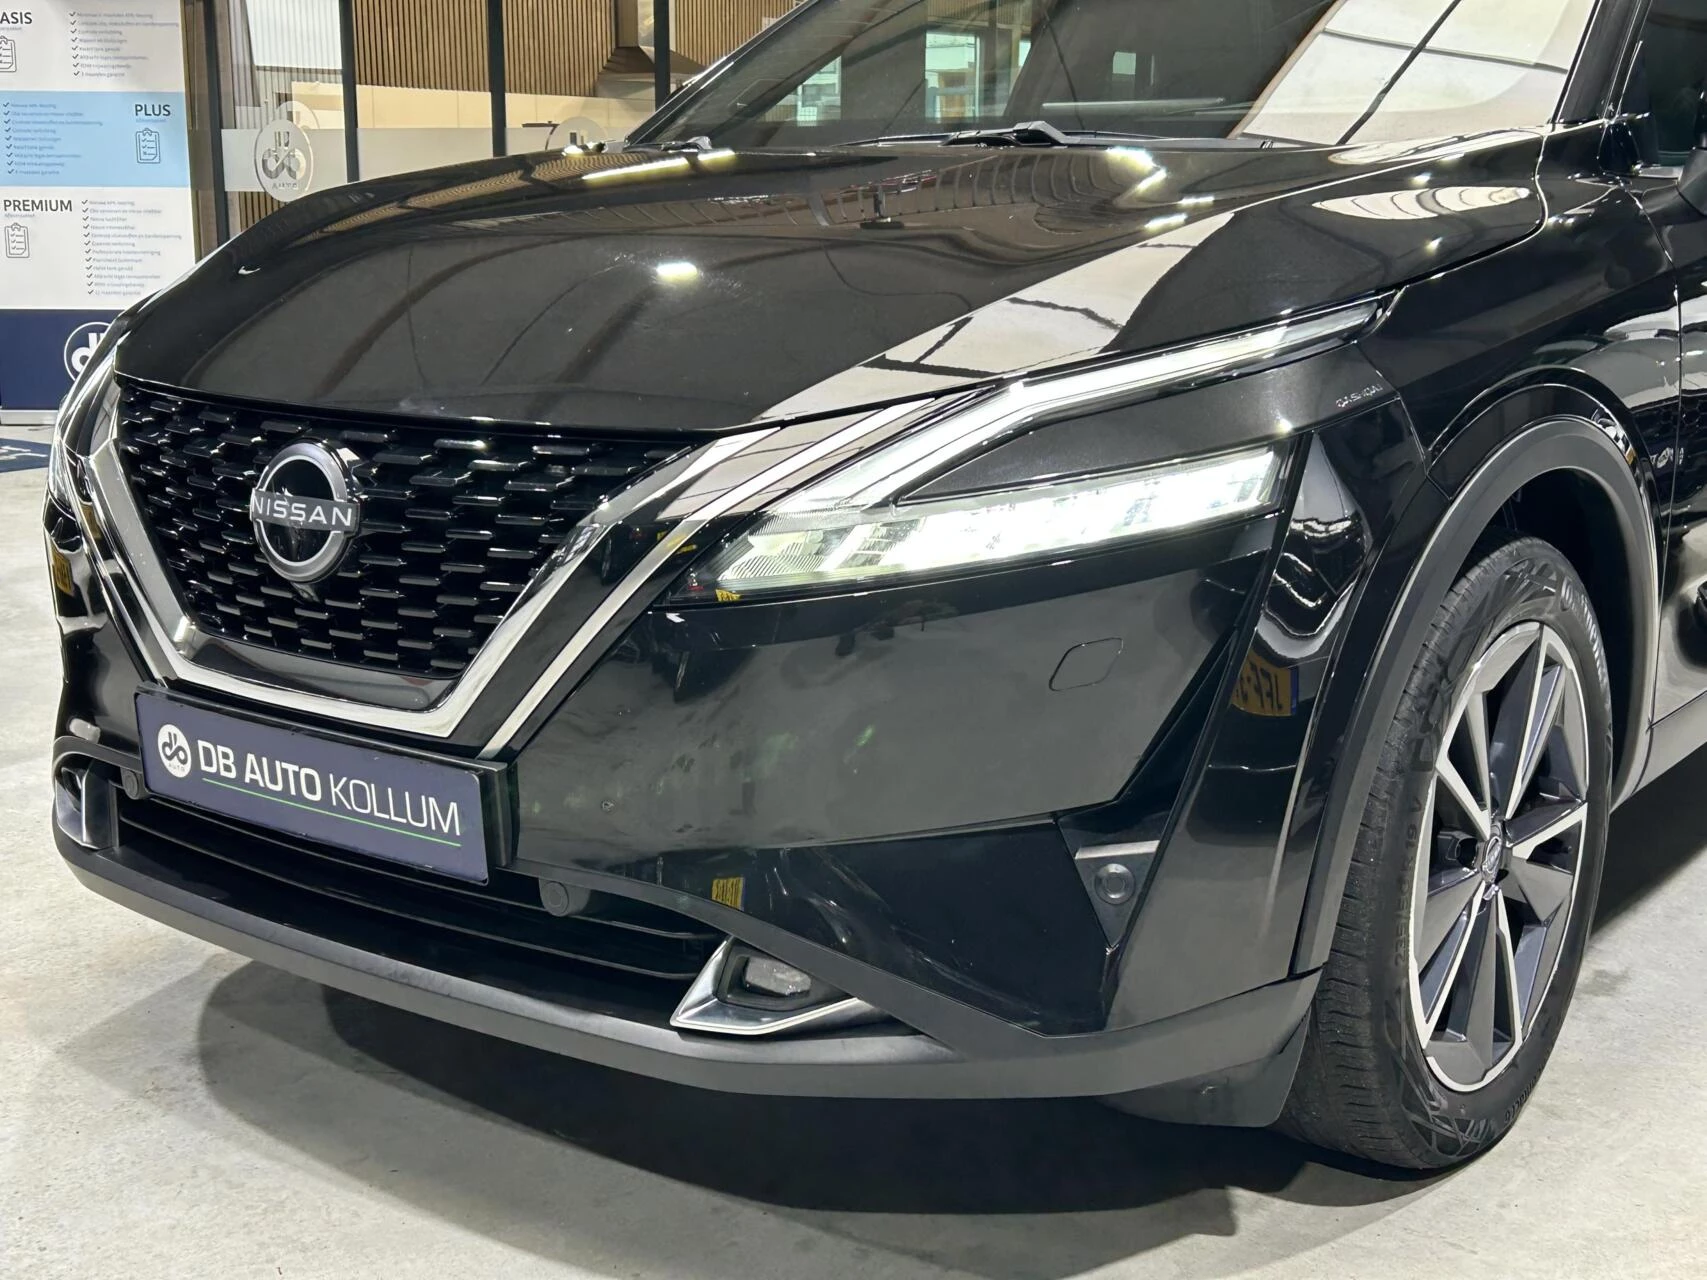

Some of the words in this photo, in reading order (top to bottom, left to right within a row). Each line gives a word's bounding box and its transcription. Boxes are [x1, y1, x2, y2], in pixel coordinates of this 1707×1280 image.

[0, 12, 32, 25] ASIS
[134, 104, 171, 117] PLUS
[3, 199, 72, 212] PREMIUM
[252, 492, 352, 526] NISSAN
[197, 739, 237, 779] DB
[244, 753, 322, 801] AUTO
[329, 773, 461, 836] KOLLUM
